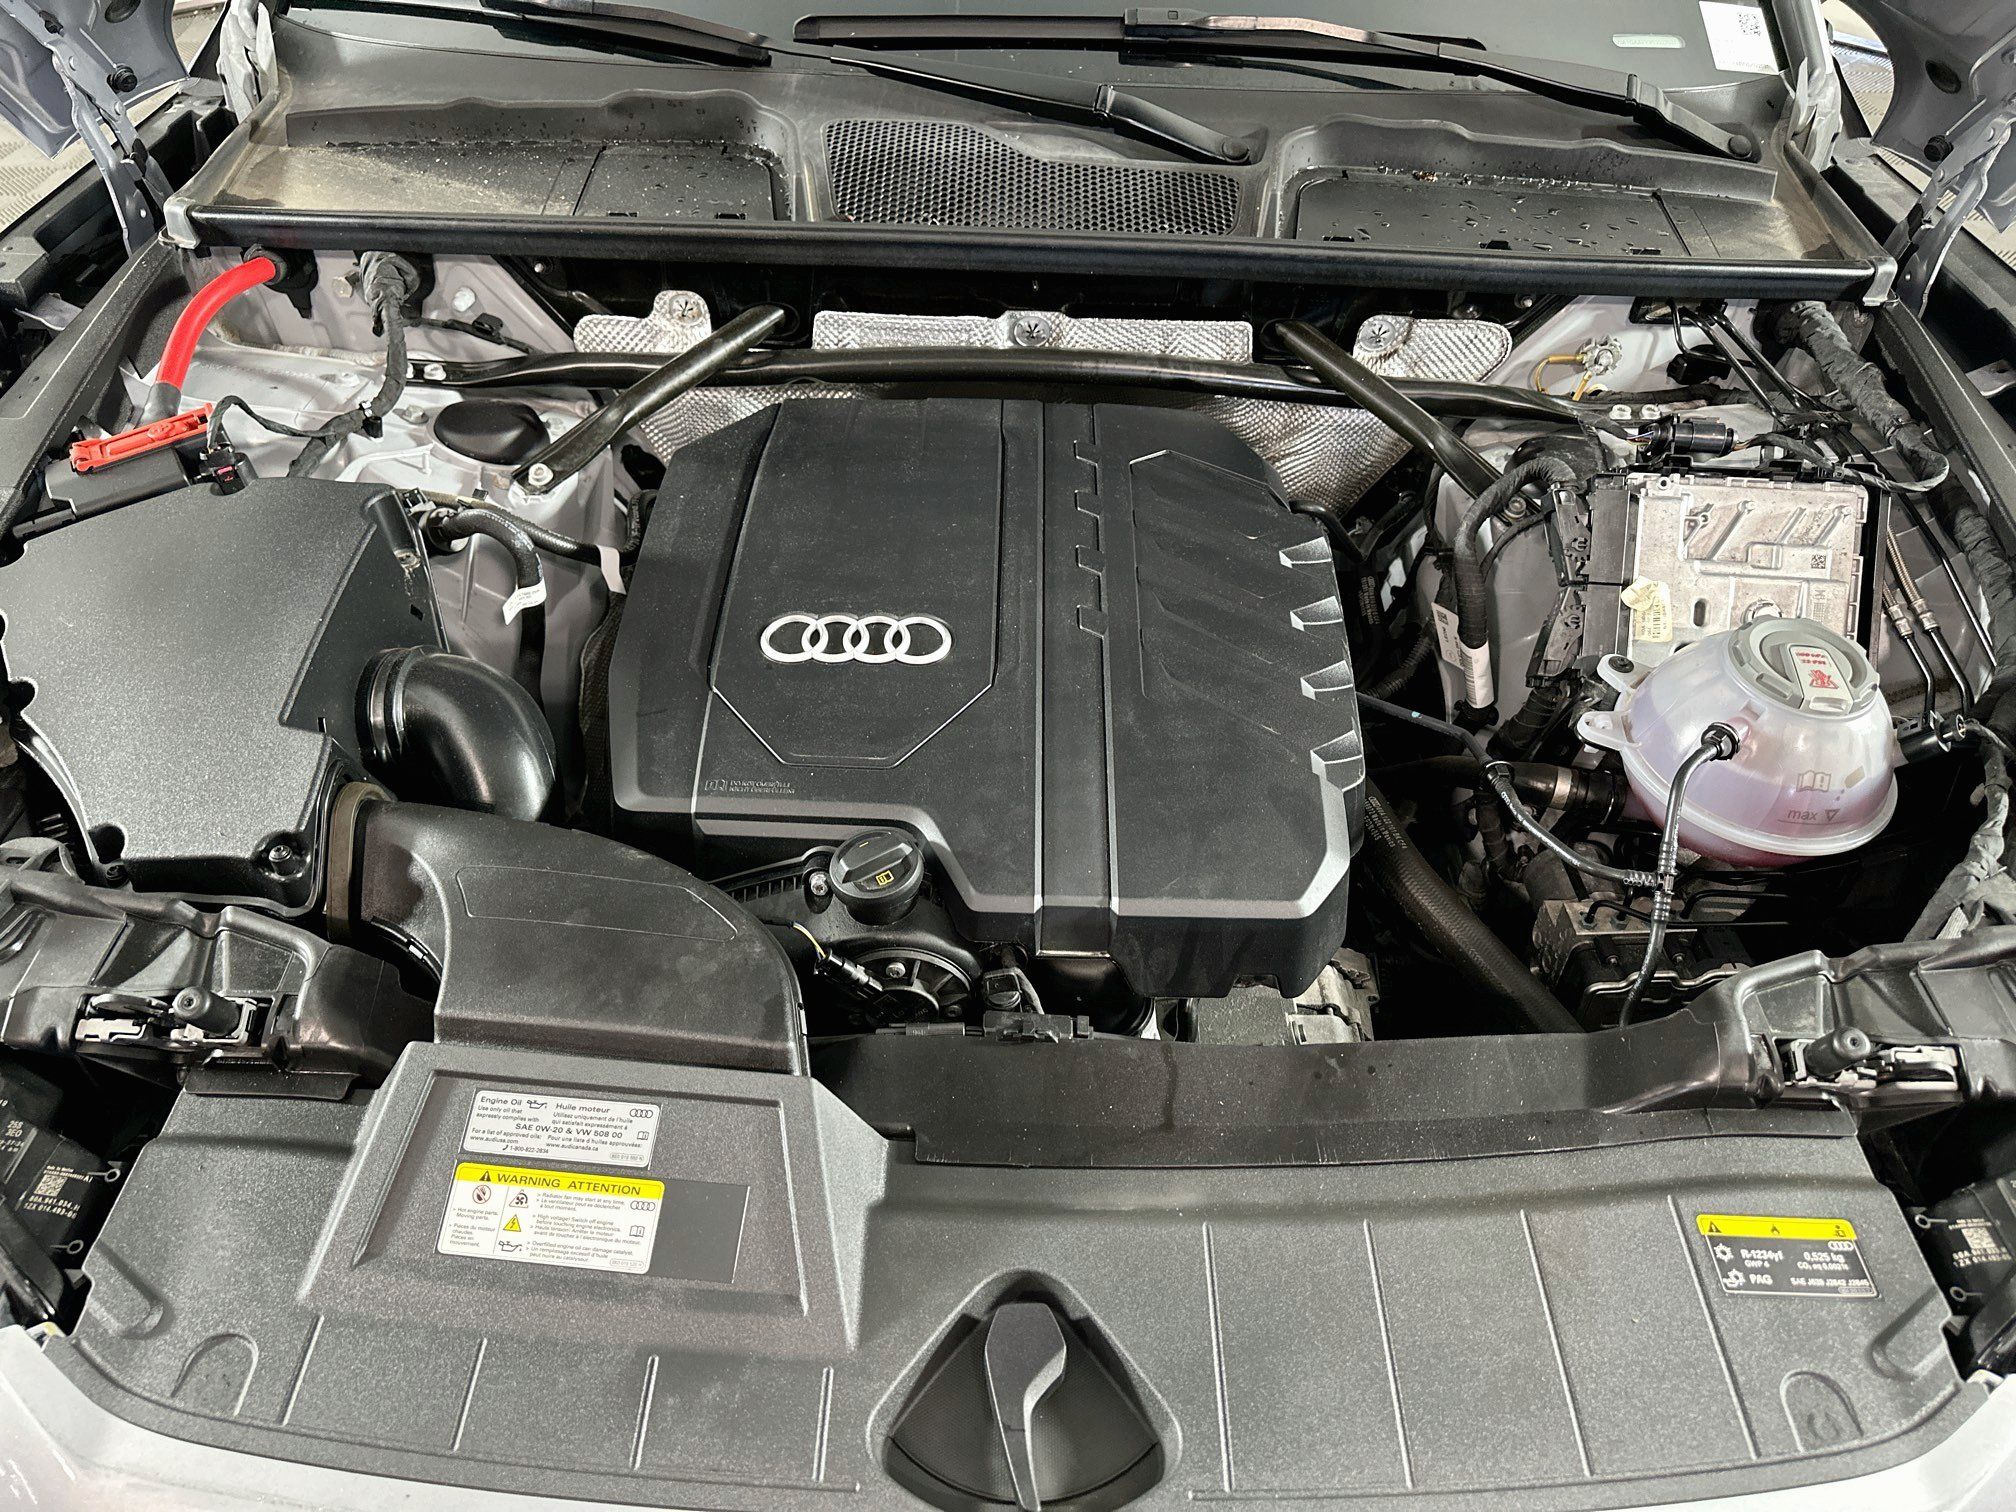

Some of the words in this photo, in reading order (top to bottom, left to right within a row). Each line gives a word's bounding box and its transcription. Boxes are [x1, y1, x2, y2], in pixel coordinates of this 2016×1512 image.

[1787, 809, 1818, 821] max
[480, 1096, 508, 1105] Engine
[510, 1098, 522, 1106] Oil
[555, 1102, 577, 1111] Huile
[578, 1105, 610, 1113] moteur
[476, 1112, 501, 1120] expressly
[502, 1114, 527, 1122] complies
[553, 1111, 573, 1119] Utilisez
[574, 1114, 607, 1122] uniquement
[502, 1131, 529, 1139] approved
[515, 1123, 533, 1131] SAE
[535, 1125, 563, 1133] 0W-20
[565, 1127, 573, 1135] &
[575, 1128, 592, 1136] VW
[593, 1130, 610, 1138] 508
[611, 1131, 623, 1139] 00
[546, 1142, 599, 1152] www.audicanada.ca
[497, 1173, 561, 1188] WARNING
[568, 1180, 641, 1196] ATTENTION
[456, 1212, 475, 1220] Moving
[532, 1240, 556, 1248] Overfilled
[592, 1246, 612, 1254] damage
[1740, 1249, 1784, 1263] R-1234yf
[1830, 1252, 1846, 1264] kg
[1744, 1260, 1763, 1268] GWP
[1749, 1273, 1773, 1286] PAG
[1790, 1277, 1807, 1286] SAE
